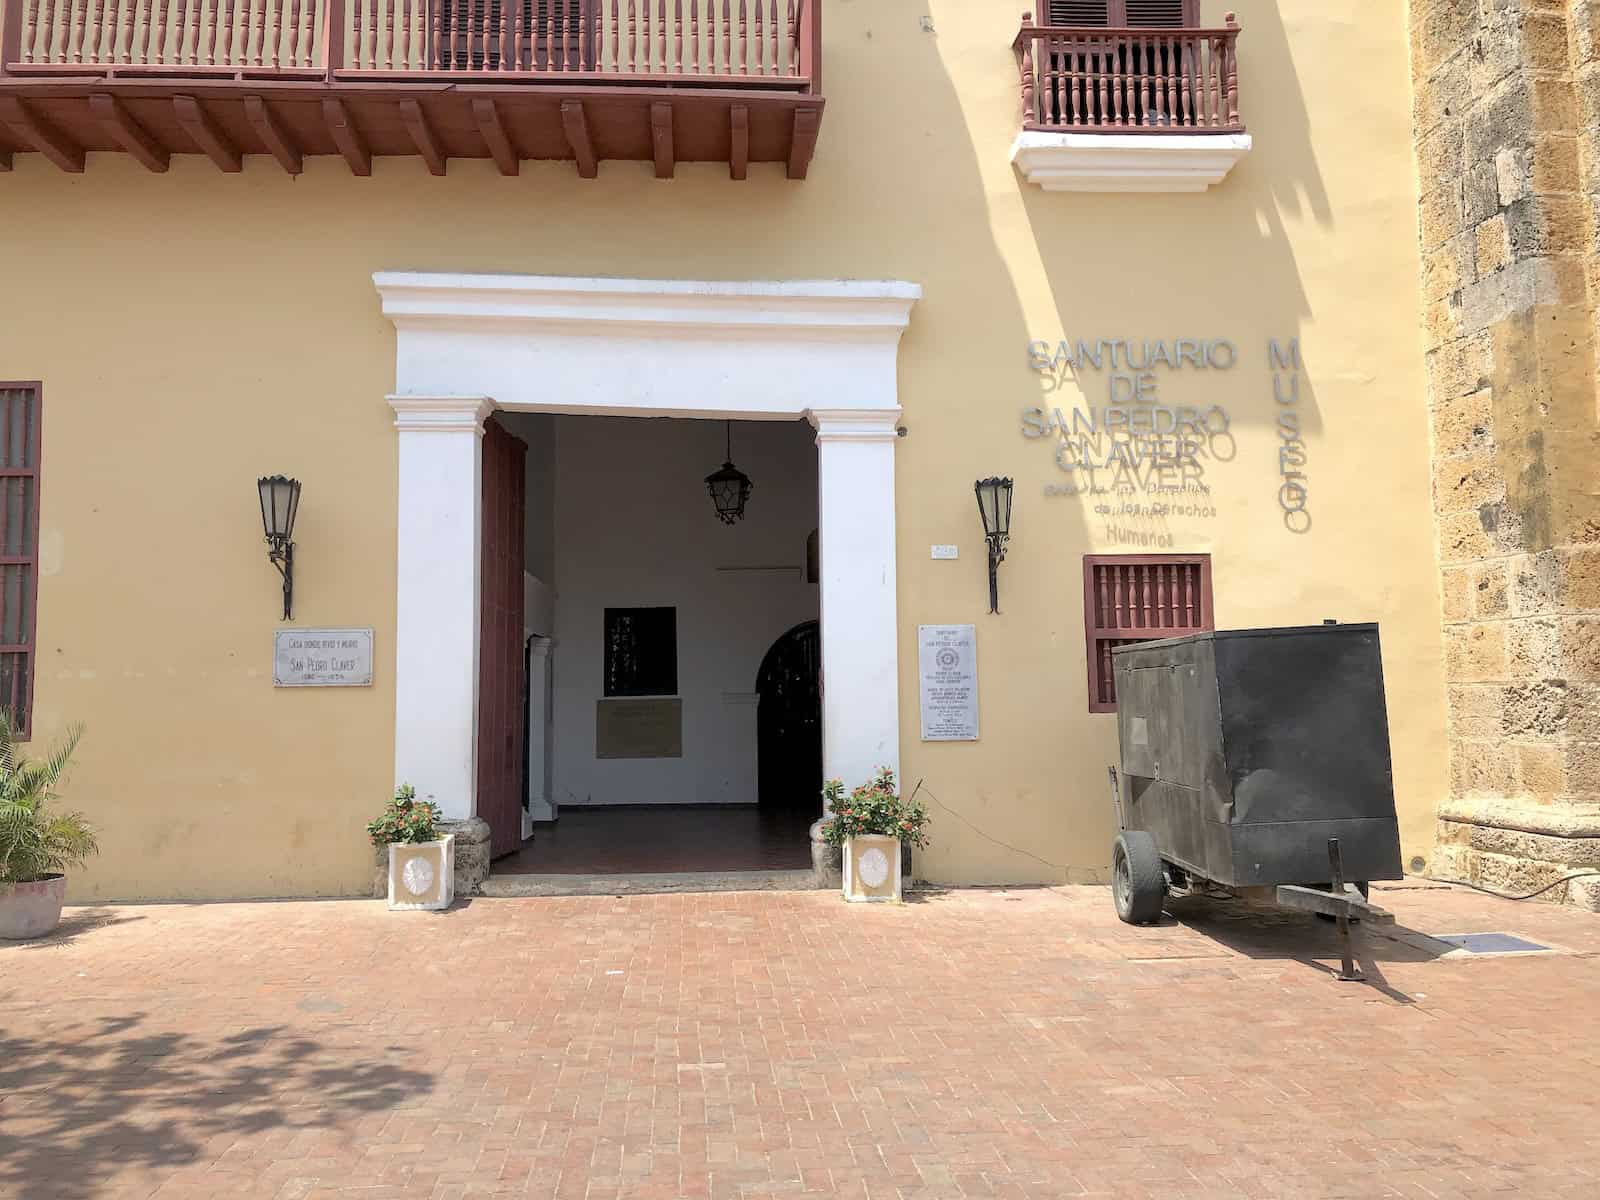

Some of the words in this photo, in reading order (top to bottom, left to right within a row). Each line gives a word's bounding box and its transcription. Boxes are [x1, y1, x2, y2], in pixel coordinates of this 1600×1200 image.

[1026, 338, 1237, 370] SANTUARIO
[1109, 371, 1159, 403] DE
[1022, 407, 1098, 438] SAN
[1102, 404, 1232, 437] PEDRO
[1055, 439, 1204, 472] CLAVER
